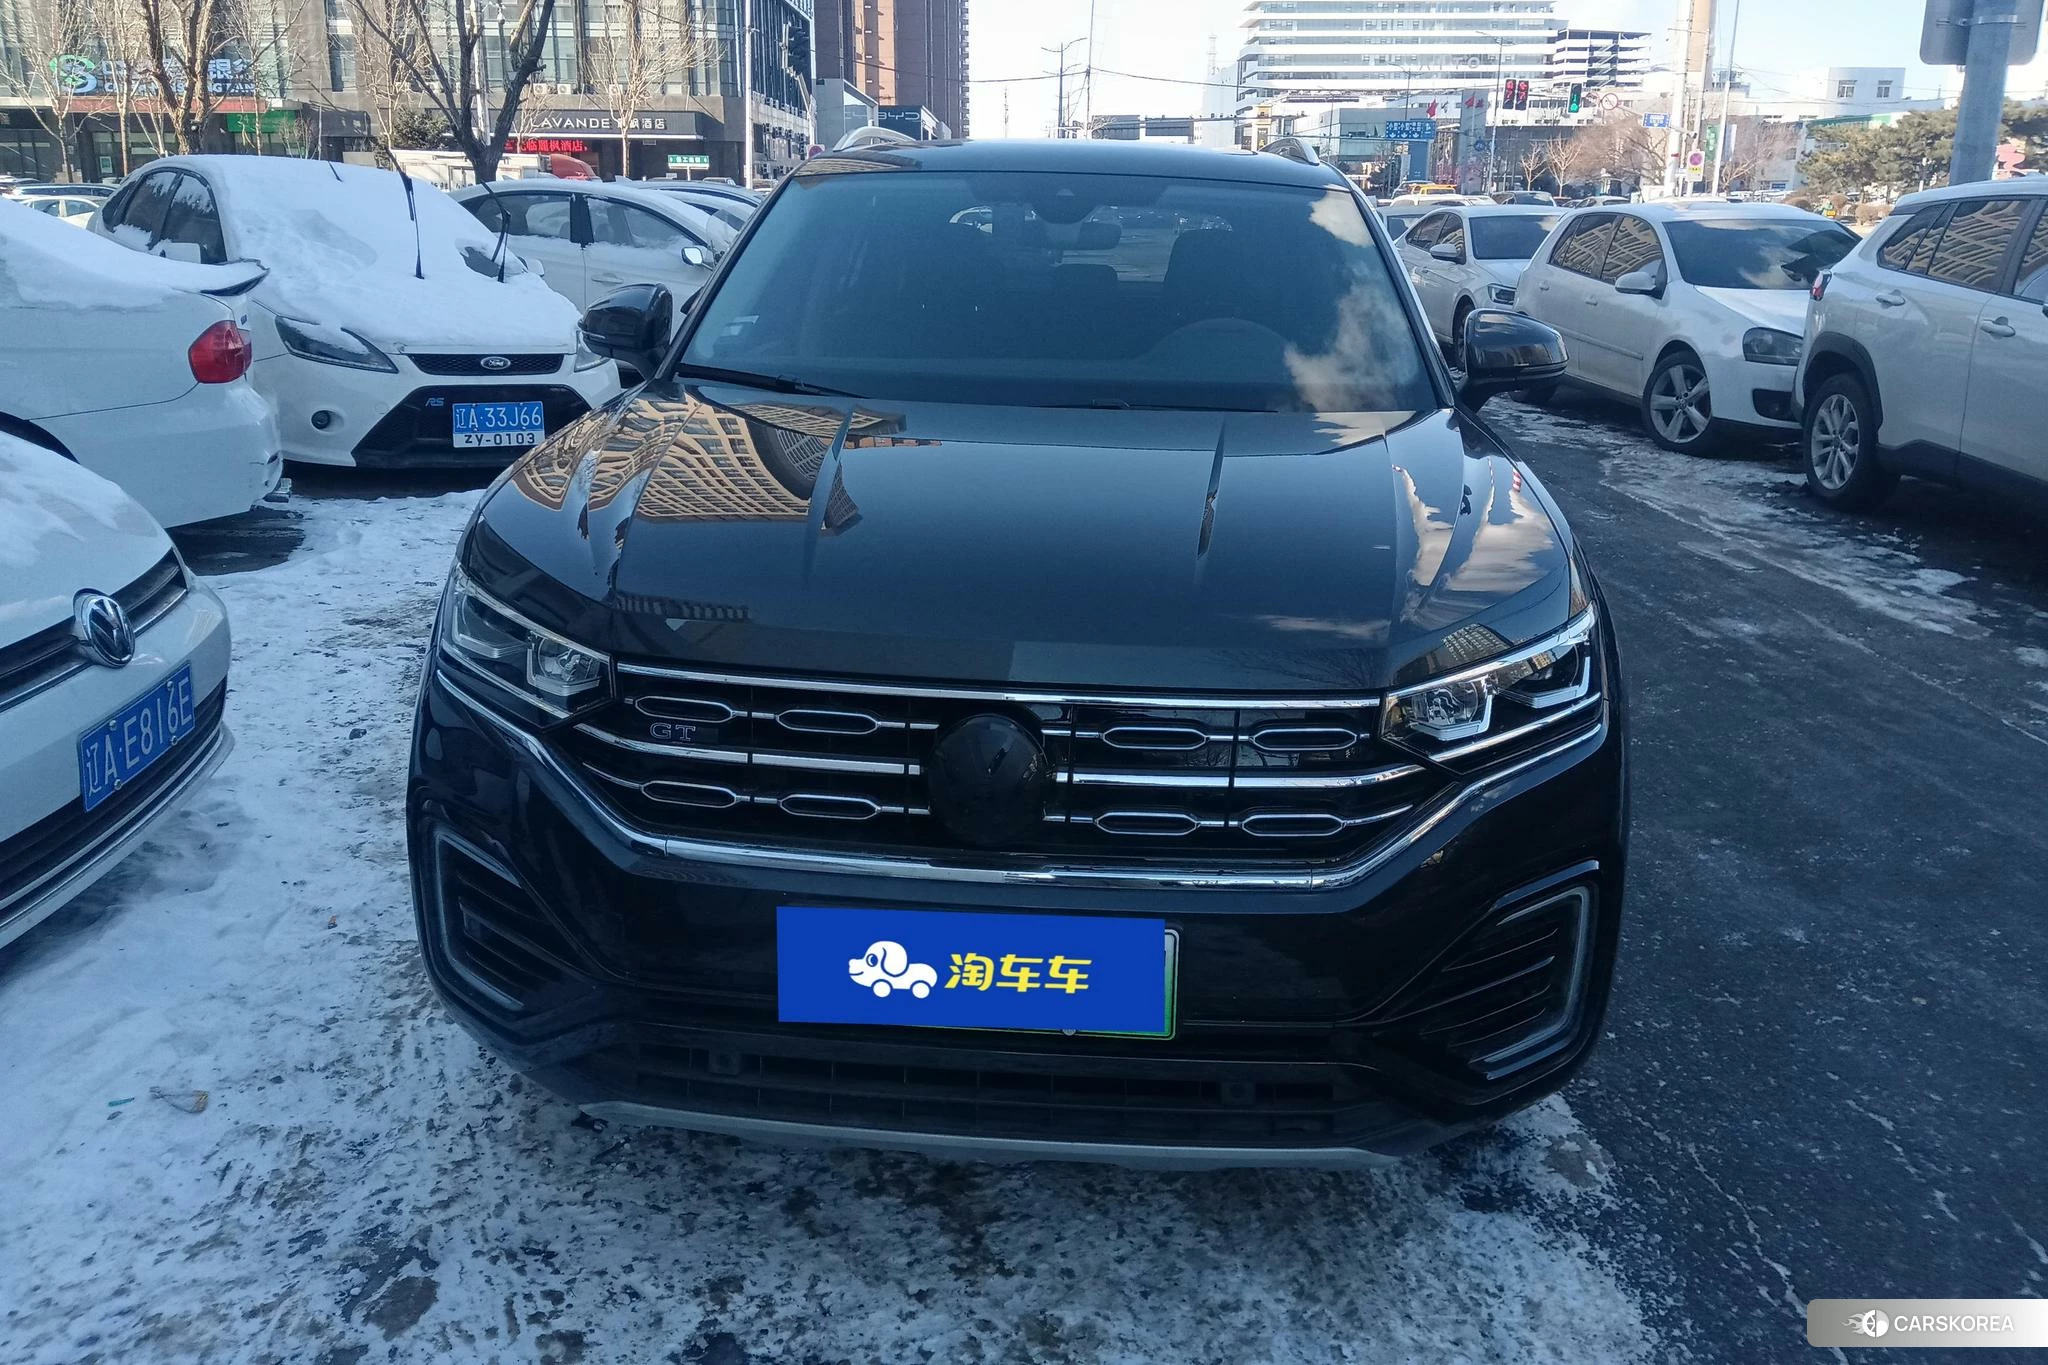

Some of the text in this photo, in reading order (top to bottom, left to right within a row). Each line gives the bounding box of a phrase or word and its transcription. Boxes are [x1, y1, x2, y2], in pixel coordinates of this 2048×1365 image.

[878, 111, 920, 120] BYD
[530, 117, 610, 129] LAVANDE
[650, 722, 697, 741] GT
